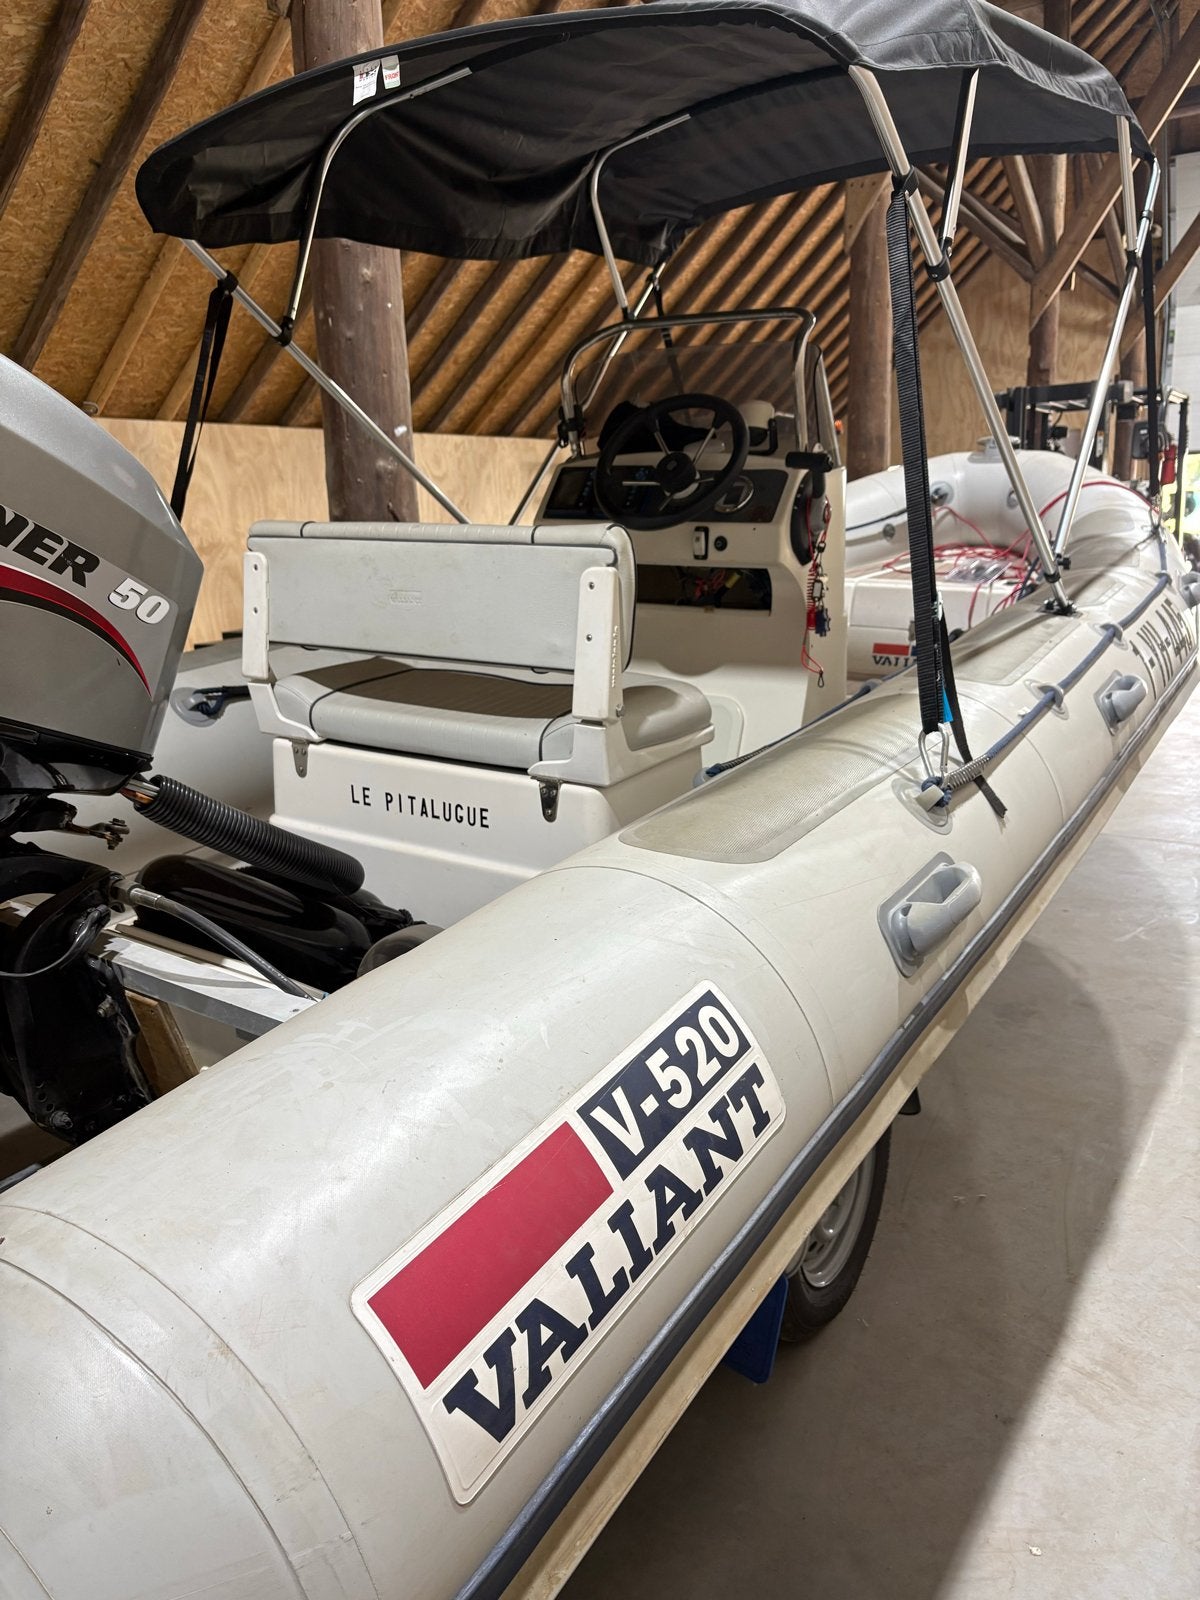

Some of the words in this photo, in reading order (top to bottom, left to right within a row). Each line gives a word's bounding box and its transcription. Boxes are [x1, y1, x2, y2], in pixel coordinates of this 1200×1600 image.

[107, 577, 170, 624] 50
[350, 784, 371, 807] LE
[385, 792, 489, 829] PITALUGUE
[590, 1004, 741, 1157] V-520
[442, 1062, 771, 1444] VALIANT
